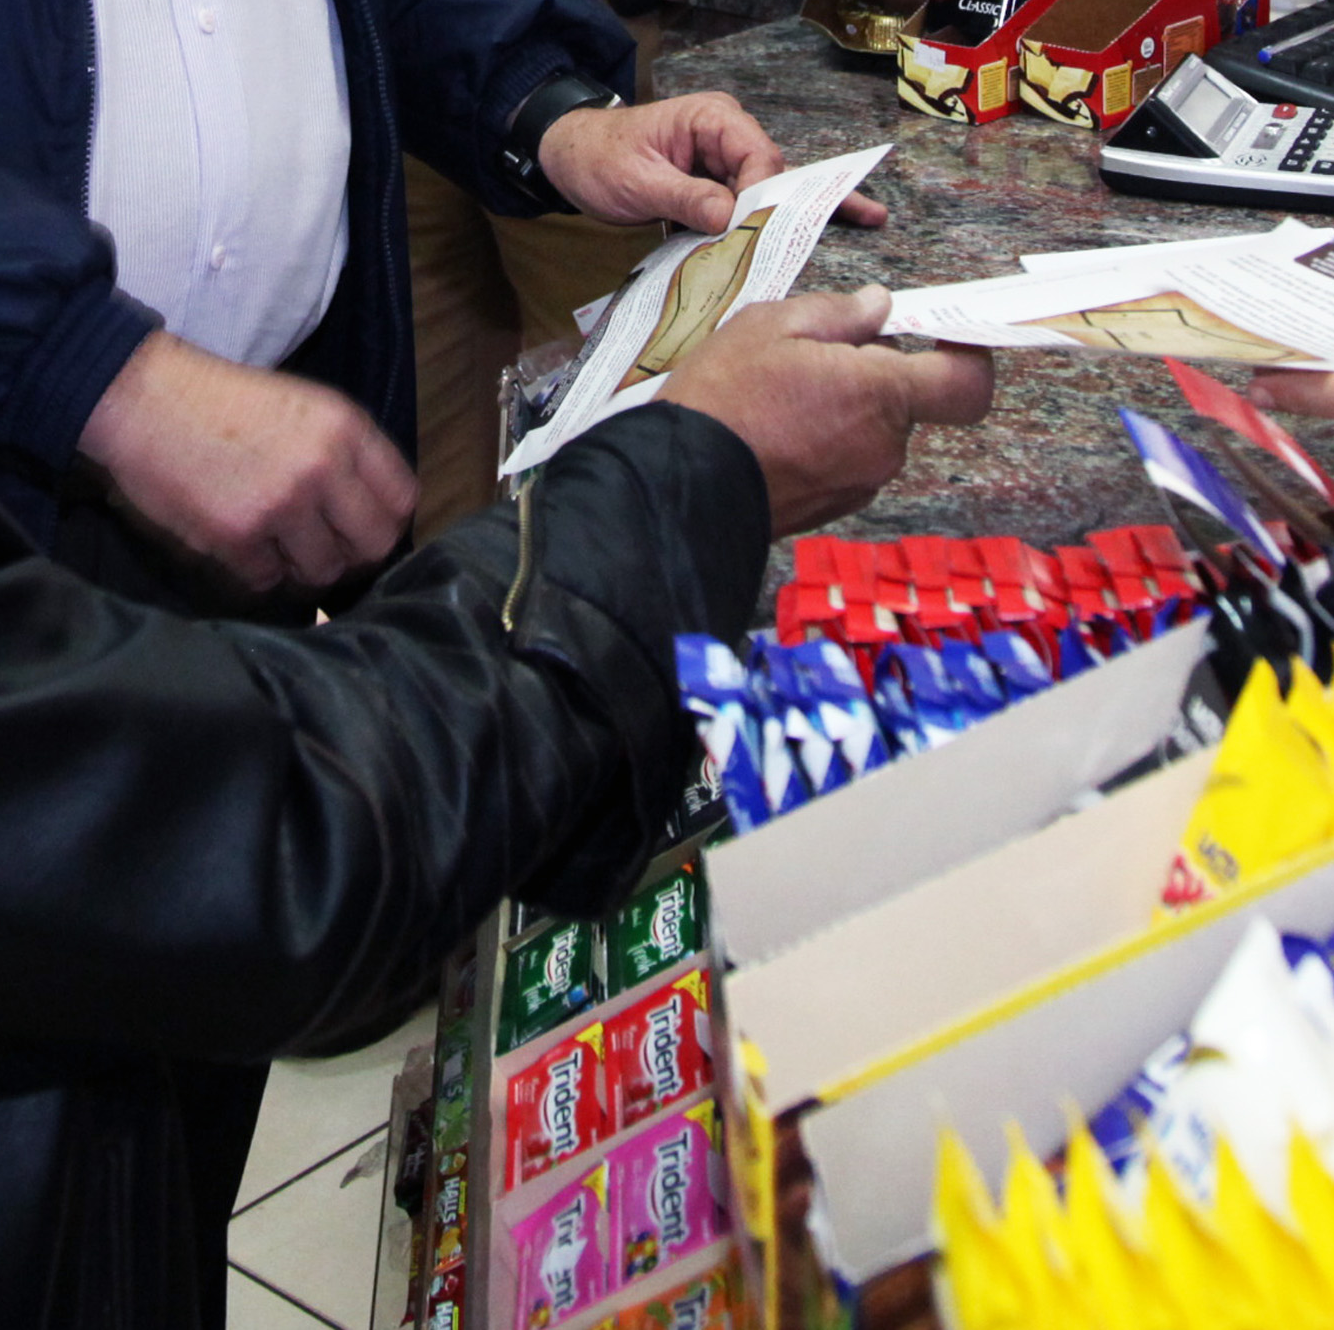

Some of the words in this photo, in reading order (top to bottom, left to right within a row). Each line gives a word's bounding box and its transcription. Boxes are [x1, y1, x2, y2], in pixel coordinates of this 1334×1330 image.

[655, 879, 684, 960] Trident
[648, 998, 684, 1099] Trident
[550, 1048, 582, 1157] Trident
[442, 1176, 460, 1225] HALLS
[657, 1128, 692, 1245] Trident
